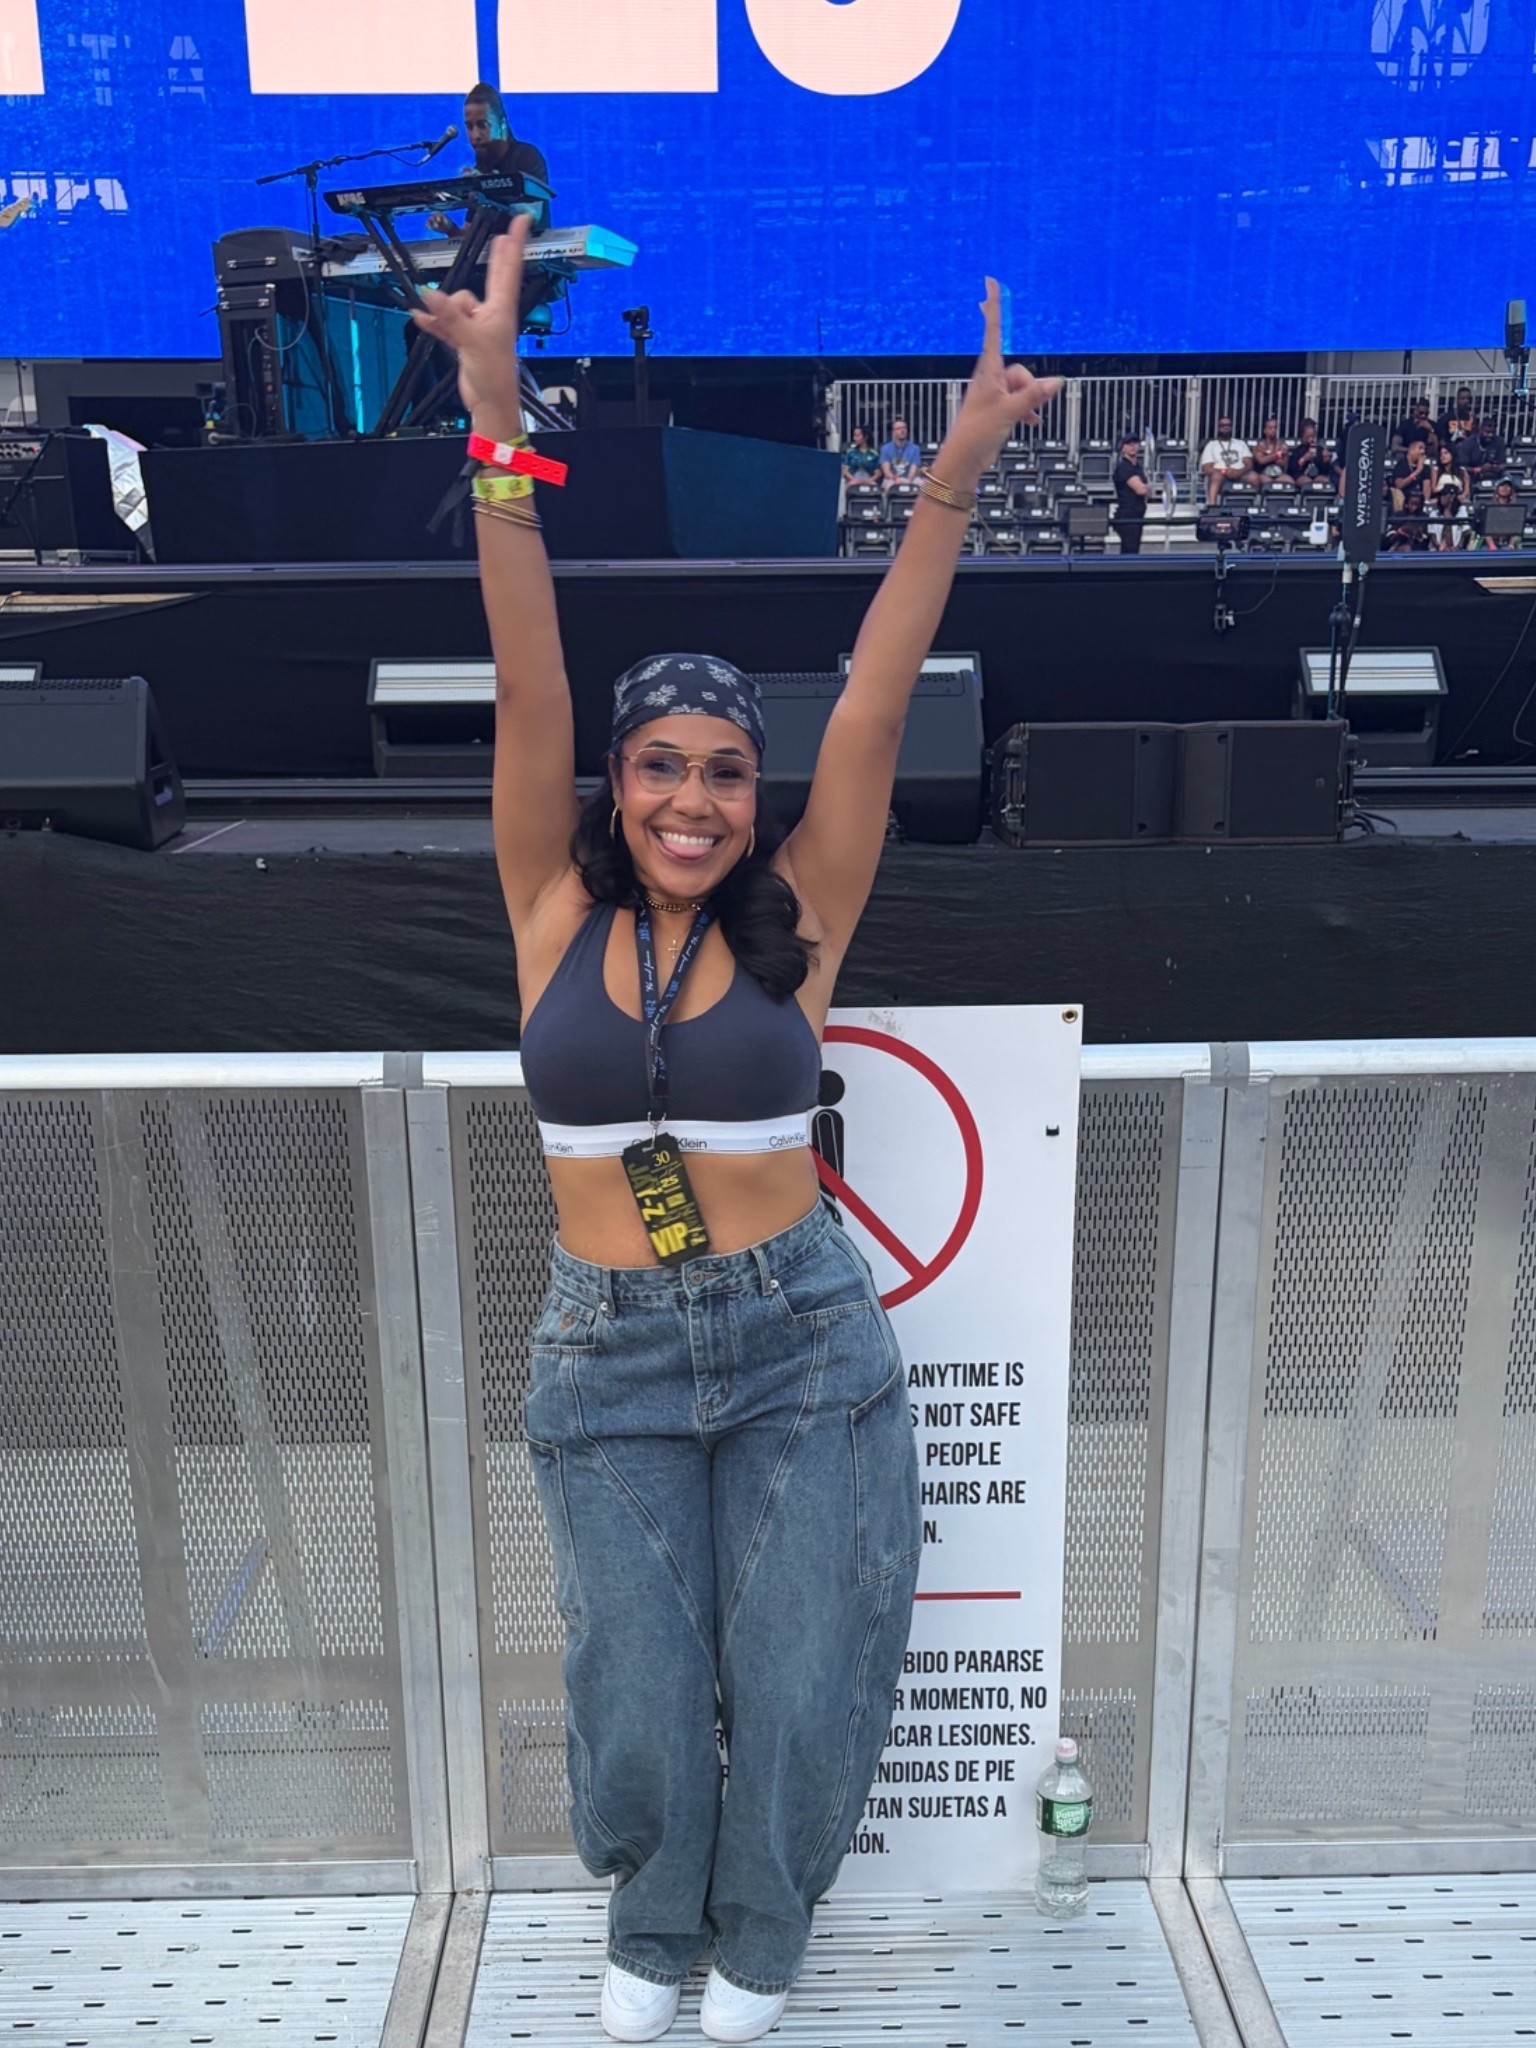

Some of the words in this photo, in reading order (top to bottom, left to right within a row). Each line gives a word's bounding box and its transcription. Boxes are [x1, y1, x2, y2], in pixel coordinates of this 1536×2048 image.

[1356, 438, 1370, 528] WISYCOM
[652, 1150, 671, 1167] 30
[649, 1222, 688, 1257] VIP
[907, 1363, 999, 1387] ANYTIME
[1005, 1362, 1024, 1387] IS
[909, 1403, 919, 1428] S
[925, 1403, 965, 1427] NOT
[970, 1402, 1021, 1427] SAFE
[926, 1442, 1001, 1466] PEOPLE
[921, 1481, 981, 1505] HAIRS
[986, 1480, 1026, 1504] ARE
[923, 1521, 943, 1544] N.
[903, 1651, 948, 1674] BIDO
[954, 1650, 1044, 1673] PARARSE
[893, 1689, 905, 1711] R
[910, 1687, 1014, 1712] MOMENTO,
[1021, 1686, 1047, 1710] NO
[885, 1725, 932, 1747] OCAR
[938, 1723, 1035, 1747] LESIONES.
[873, 1761, 949, 1783] NDIDAS
[955, 1760, 979, 1782] DE
[985, 1760, 1015, 1782] PIE
[862, 1797, 902, 1819] TAN
[908, 1796, 988, 1818] SUJETAS
[994, 1796, 1007, 1817] A
